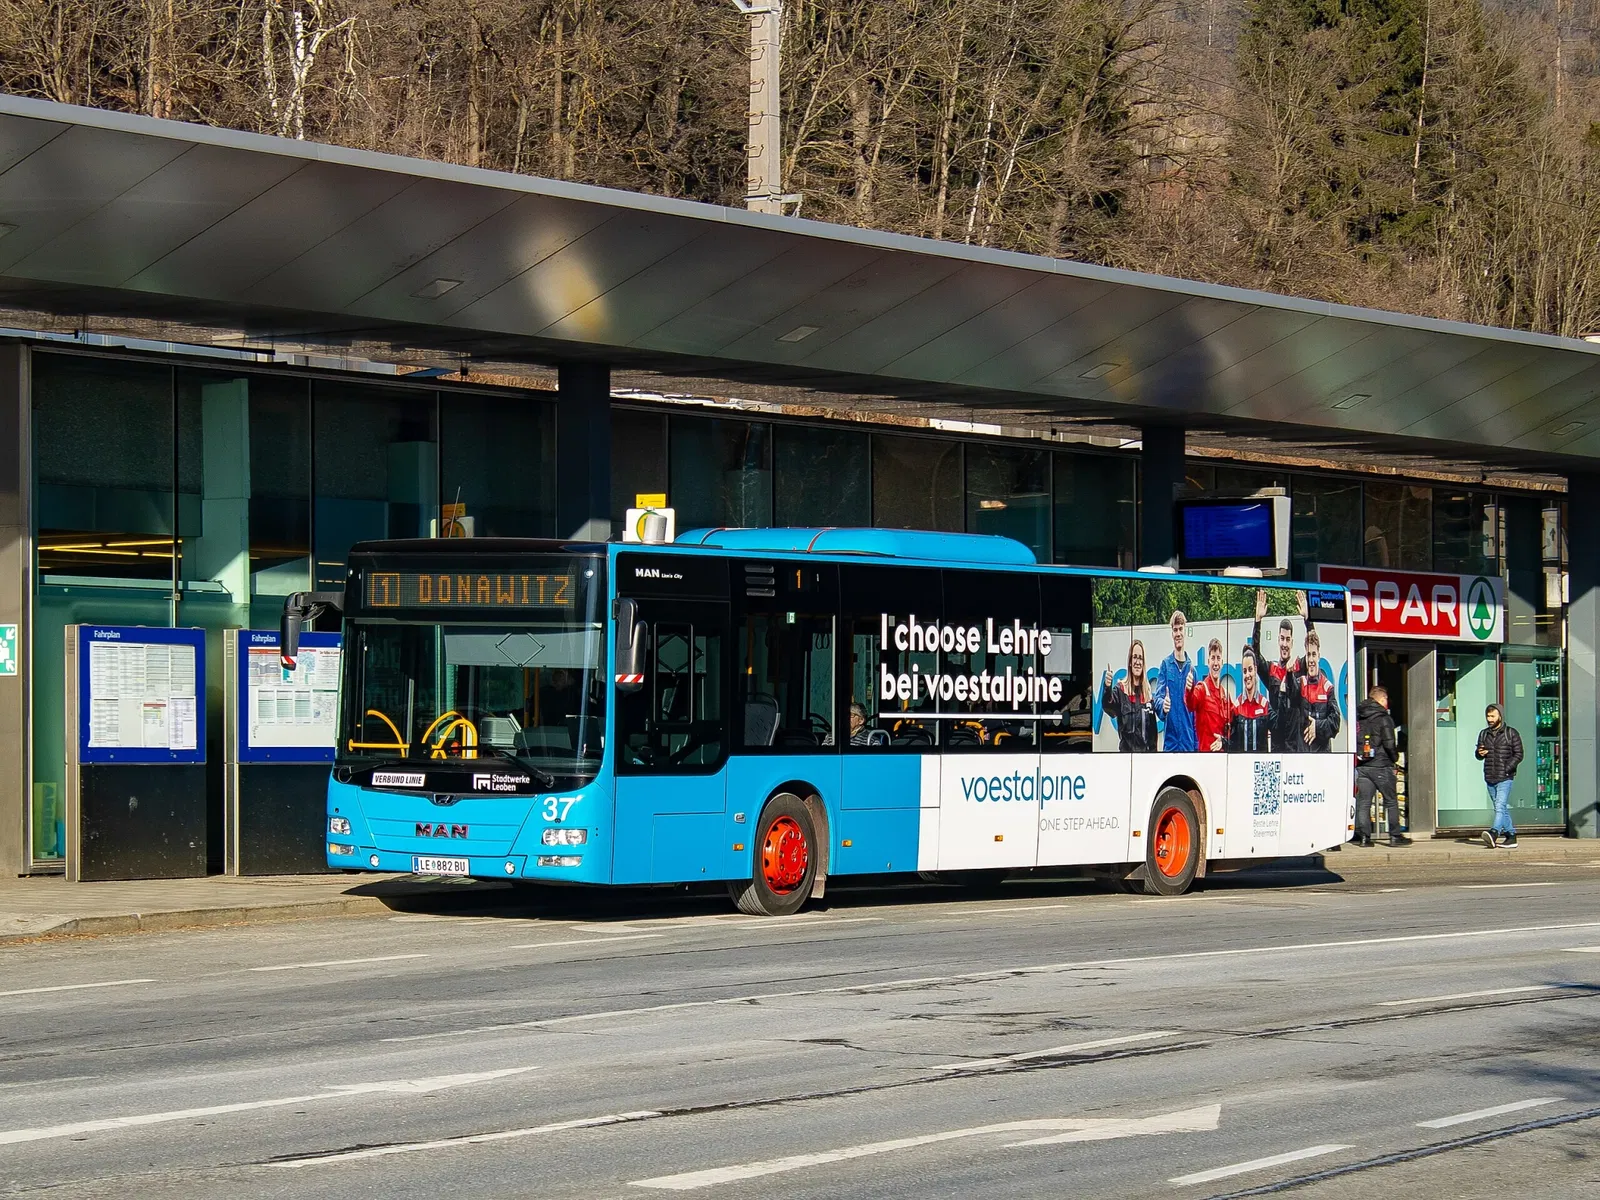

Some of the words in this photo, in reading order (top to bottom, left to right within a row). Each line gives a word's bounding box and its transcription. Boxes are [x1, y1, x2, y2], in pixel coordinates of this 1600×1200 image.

[635, 568, 660, 578] MAN
[796, 569, 801, 589] 1
[381, 576, 389, 605] 1
[418, 575, 569, 604] DONAWITZ
[1346, 578, 1457, 628] SPAR
[94, 630, 121, 640] Fahrplan
[251, 634, 277, 644] Fahrplan
[881, 613, 887, 651] I
[894, 614, 981, 653] choose
[987, 617, 1052, 656] Lehre
[881, 663, 919, 700] bei
[924, 666, 1063, 711] voestalpine
[375, 775, 404, 784] VERBUND
[405, 776, 423, 785] LINIE
[492, 774, 530, 784] Stadtwerke
[1283, 772, 1304, 785] Jetzt
[492, 783, 516, 791] Leoben
[961, 766, 1086, 810] voestalpine
[1283, 789, 1325, 803] bewerben!
[542, 796, 583, 822] 37
[415, 822, 470, 839] MAN
[1040, 818, 1061, 832] ONE
[1063, 817, 1085, 831] STEP
[1085, 816, 1120, 829] AHEAD.
[420, 860, 430, 871] LE
[437, 860, 452, 871] 882
[454, 861, 466, 872] BU
